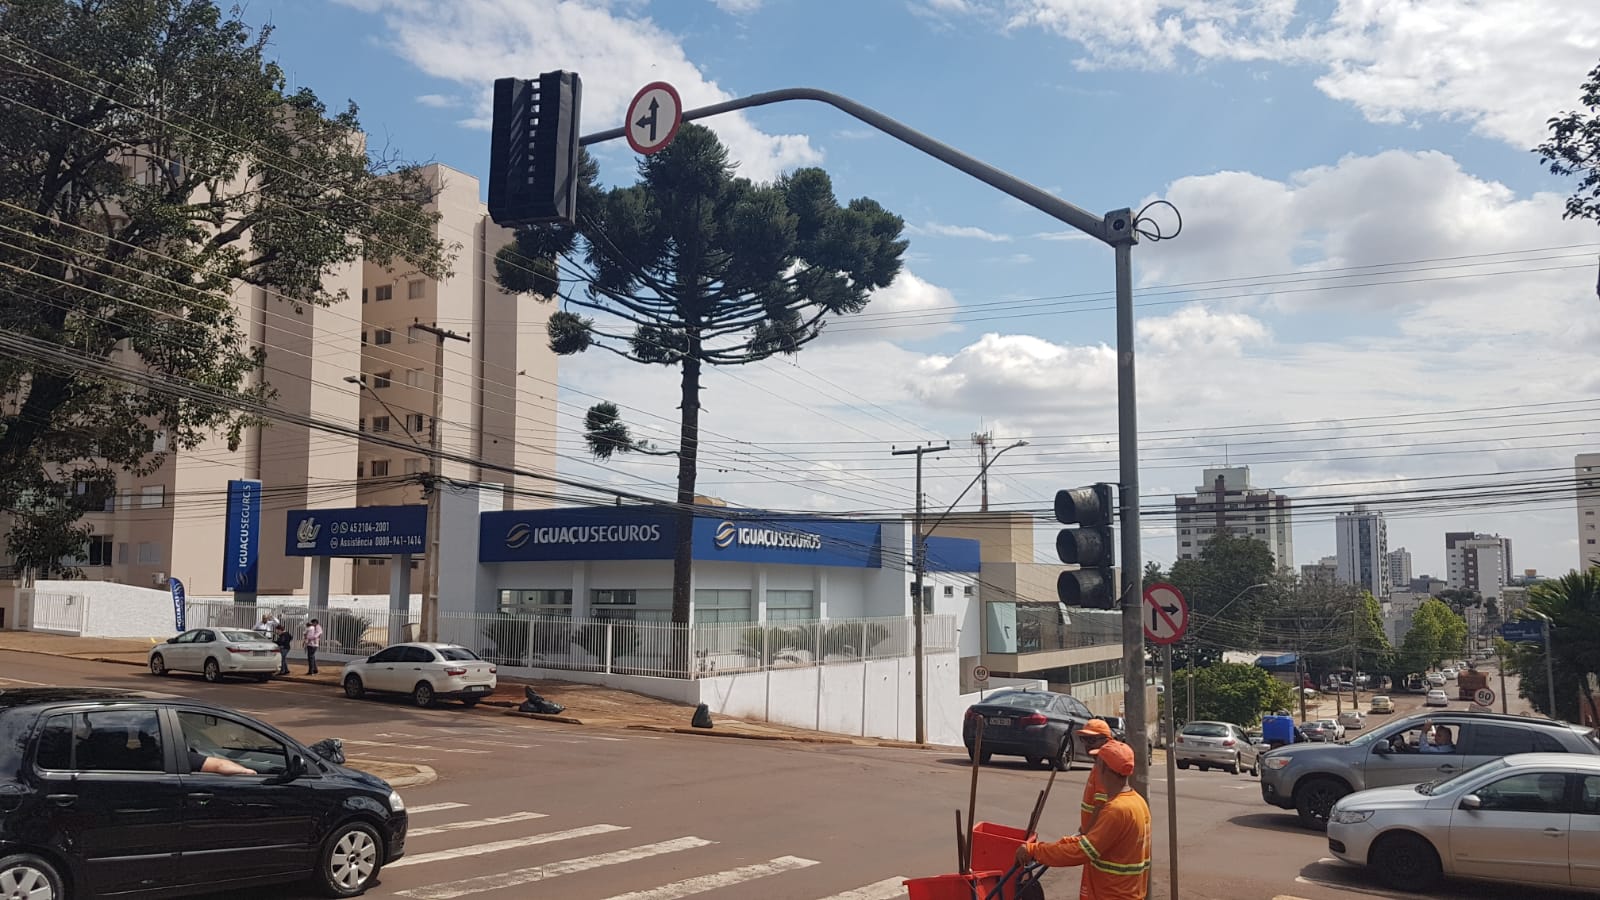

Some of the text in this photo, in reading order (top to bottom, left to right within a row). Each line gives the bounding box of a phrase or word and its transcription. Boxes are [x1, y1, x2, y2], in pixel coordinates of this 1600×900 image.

[340, 537, 373, 547] Assistência
[534, 524, 661, 545] IGUAÇUSEGUROS
[738, 527, 821, 549] IGUAÇUSEGUROS
[1478, 691, 1491, 700] 60
